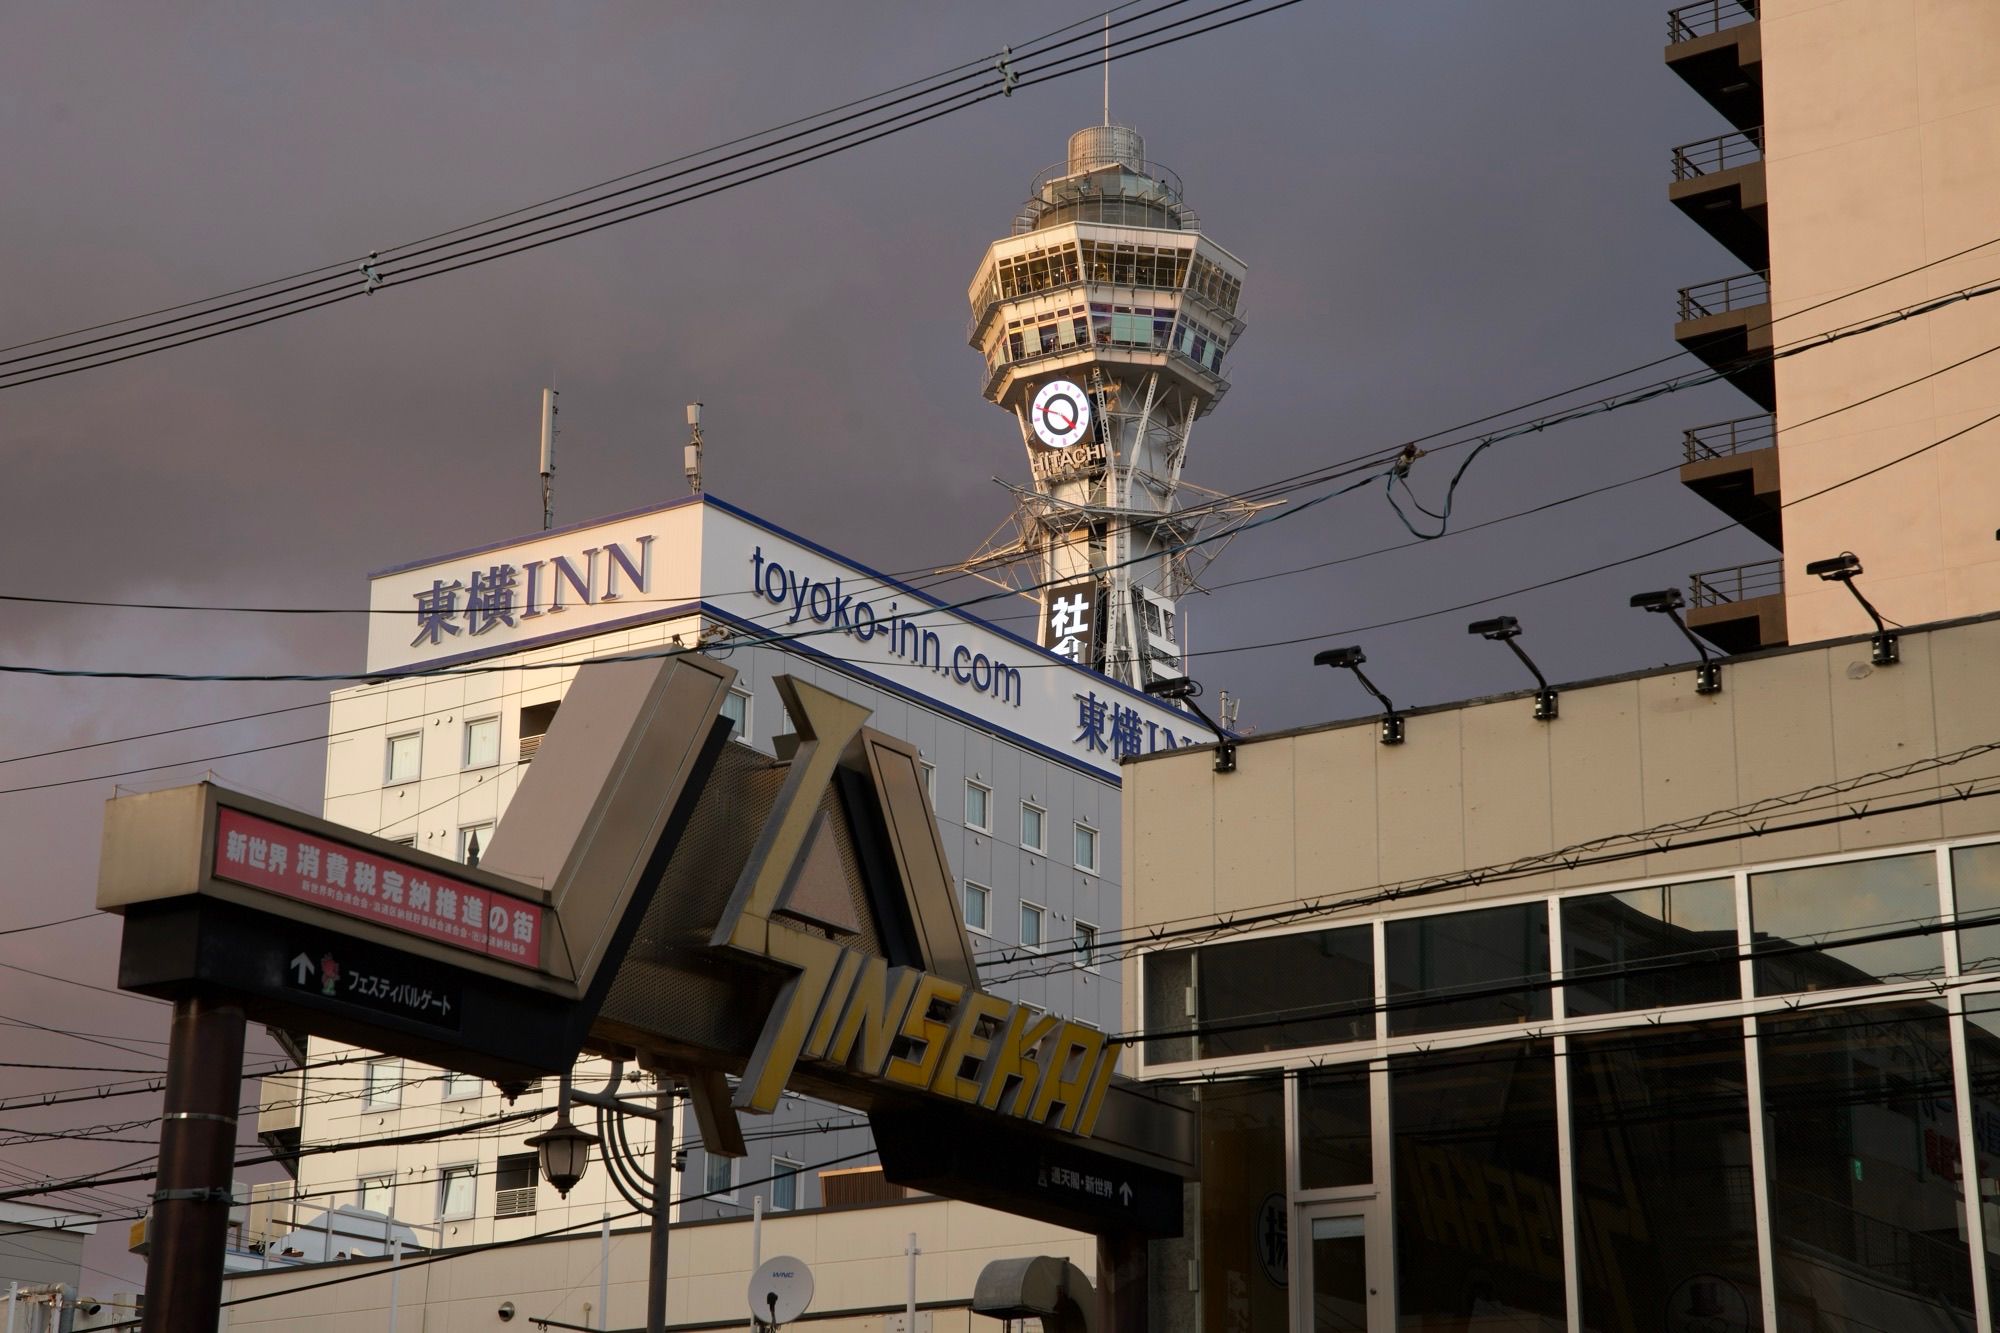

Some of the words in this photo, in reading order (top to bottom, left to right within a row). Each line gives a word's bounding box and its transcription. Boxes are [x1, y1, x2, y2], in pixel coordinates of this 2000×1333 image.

[1031, 443, 1106, 471] HITACHI
[410, 535, 657, 648] 東横INN
[751, 546, 1022, 708] toyoko-inn.com
[1073, 691, 1207, 761] 東横I
[348, 970, 452, 1016] フェスティバルゲート
